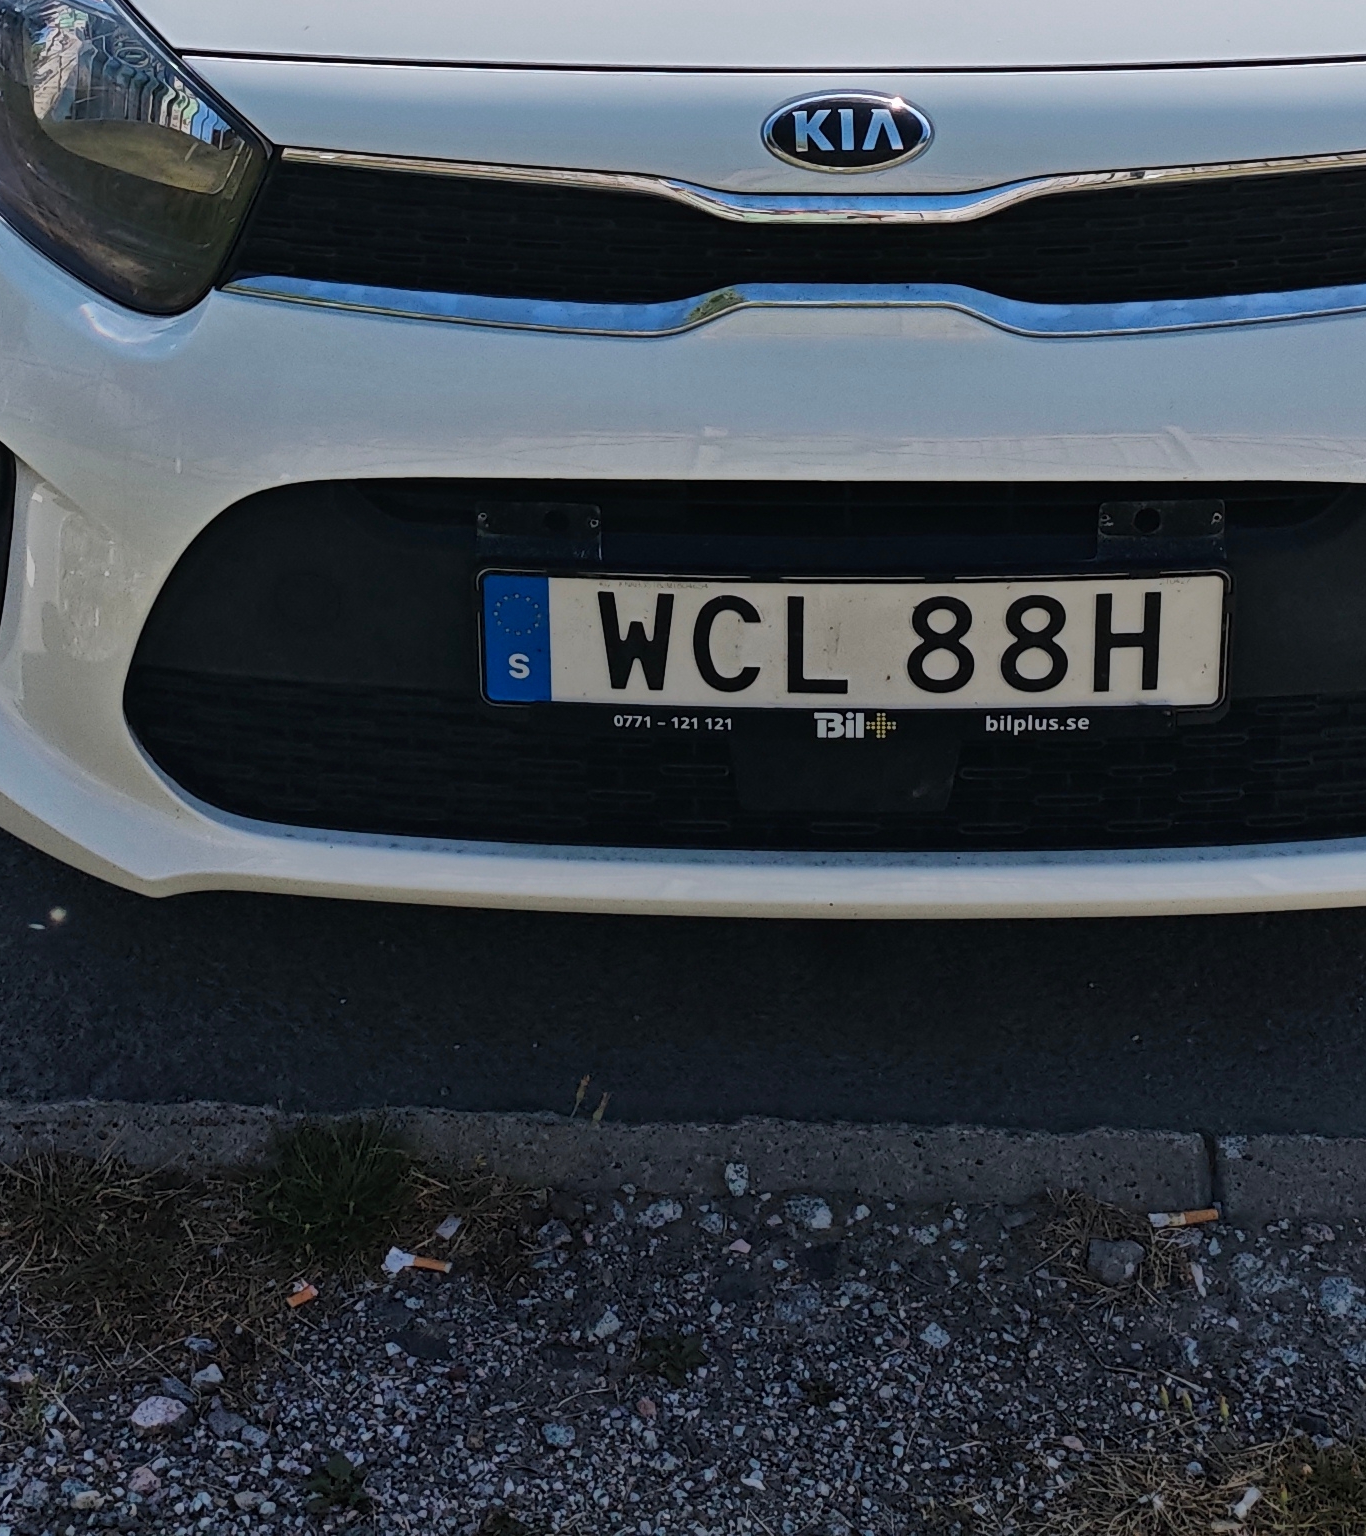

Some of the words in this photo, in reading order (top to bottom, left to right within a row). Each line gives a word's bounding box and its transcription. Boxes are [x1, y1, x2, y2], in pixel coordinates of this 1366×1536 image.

[792, 108, 904, 153] KIA
[597, 590, 849, 695] WCL
[907, 591, 1162, 694] 88H
[508, 653, 531, 679] S
[613, 715, 651, 728] 0771
[671, 717, 699, 730] 121
[705, 717, 733, 731] 121
[985, 714, 1090, 735] bilplus.se
